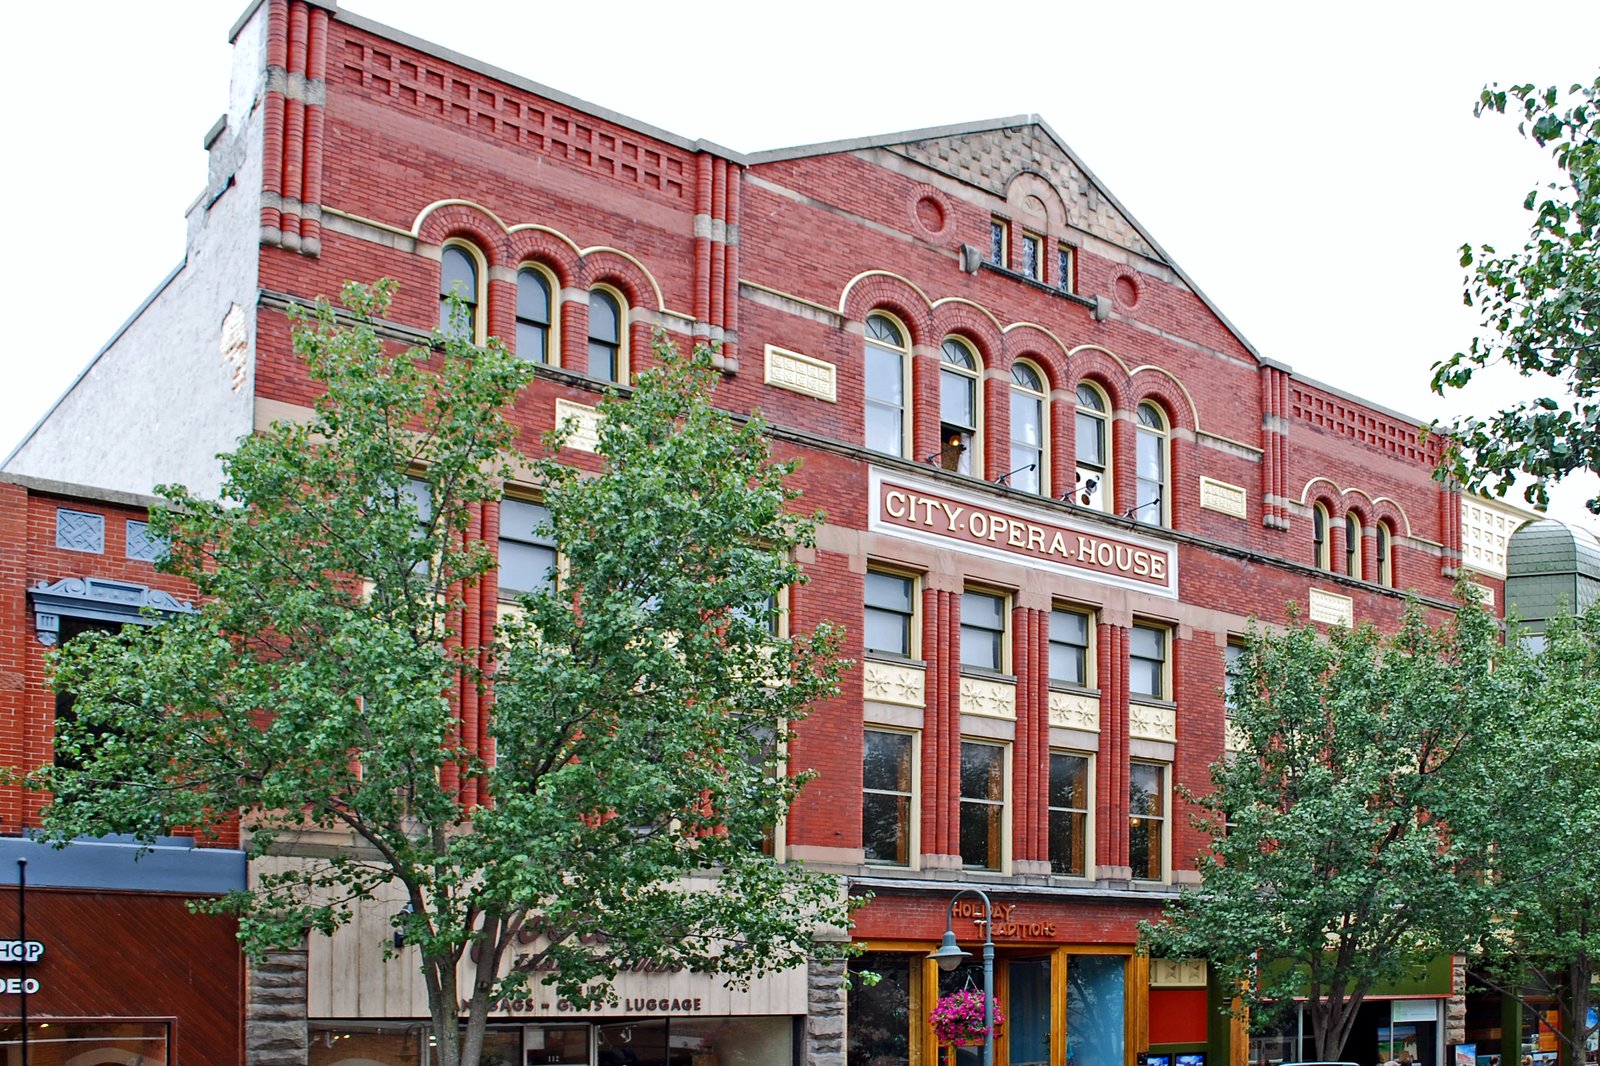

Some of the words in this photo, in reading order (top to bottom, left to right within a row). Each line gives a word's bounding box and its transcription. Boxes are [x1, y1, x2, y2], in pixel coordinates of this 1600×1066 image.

[1077, 535, 1166, 580] HOUSE
[952, 901, 1013, 922] HOLIAY
[625, 998, 702, 1012] LUGGAGE
